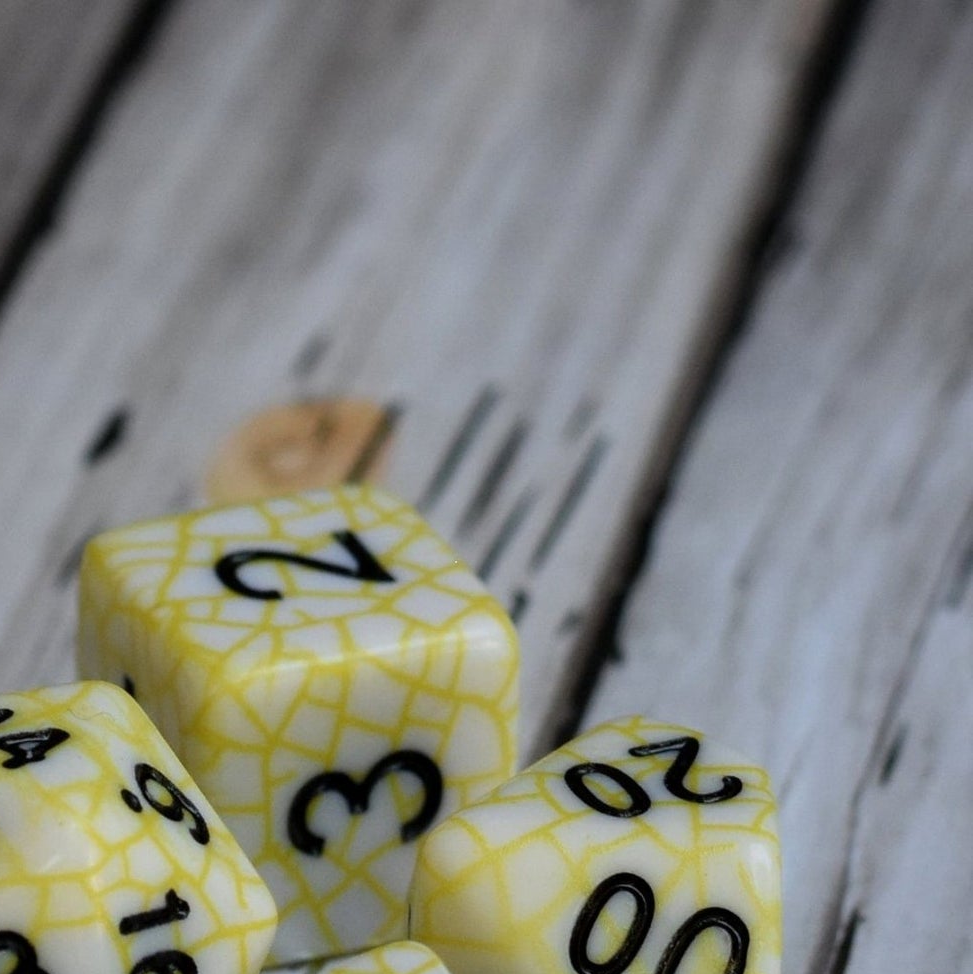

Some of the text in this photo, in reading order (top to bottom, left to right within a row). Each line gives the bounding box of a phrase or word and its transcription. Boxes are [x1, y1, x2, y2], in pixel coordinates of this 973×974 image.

[214, 529, 396, 602] 2
[285, 748, 445, 859] 3
[563, 734, 743, 820] 20
